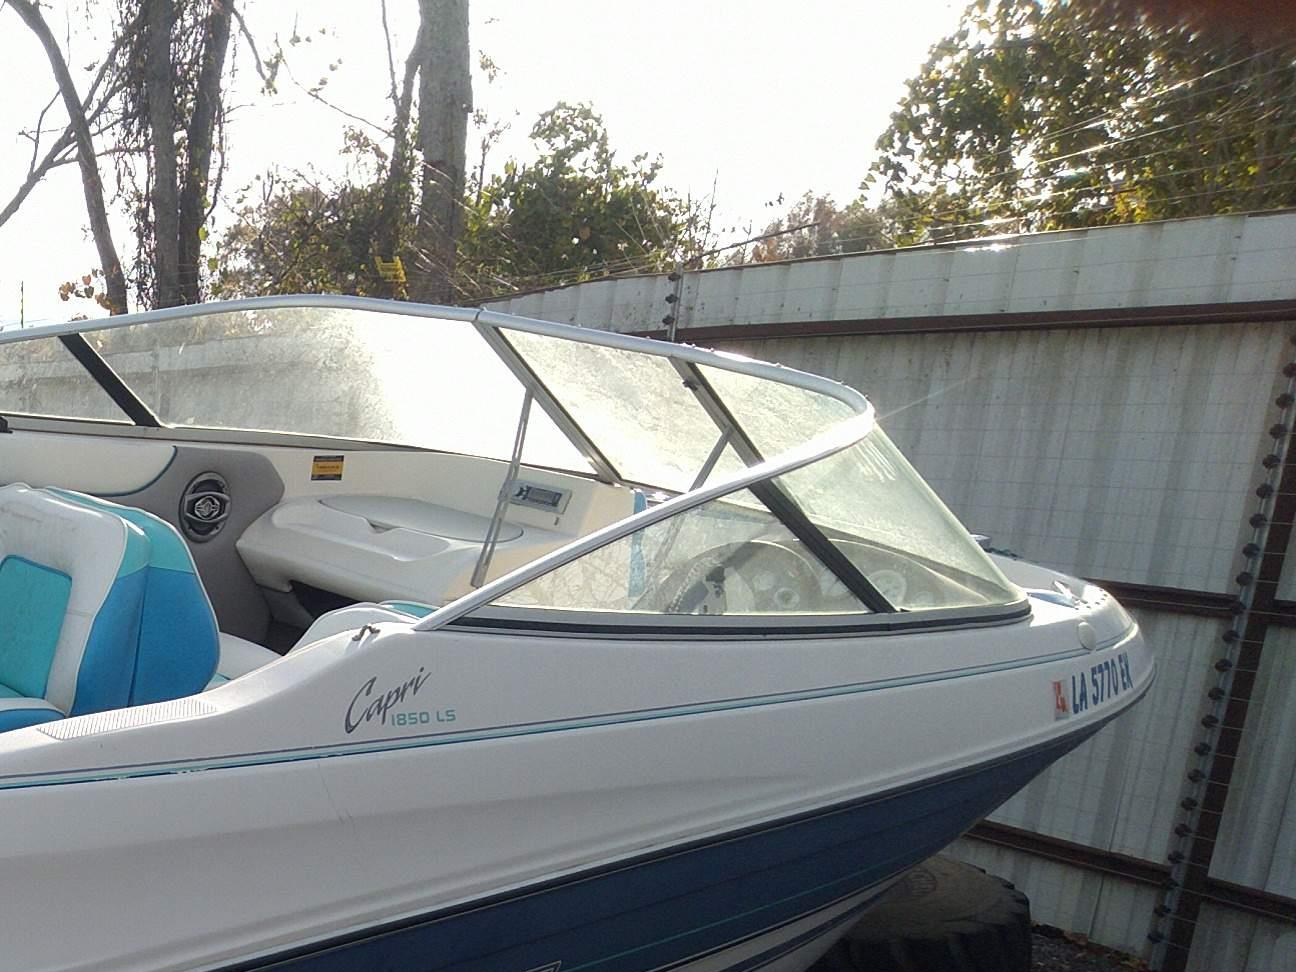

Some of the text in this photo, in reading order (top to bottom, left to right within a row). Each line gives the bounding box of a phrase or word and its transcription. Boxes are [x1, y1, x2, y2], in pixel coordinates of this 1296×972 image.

[344, 666, 432, 735] Capri
[1072, 672, 1088, 714] LA
[1090, 658, 1118, 706] 5770
[391, 709, 457, 727] 1850 LS
